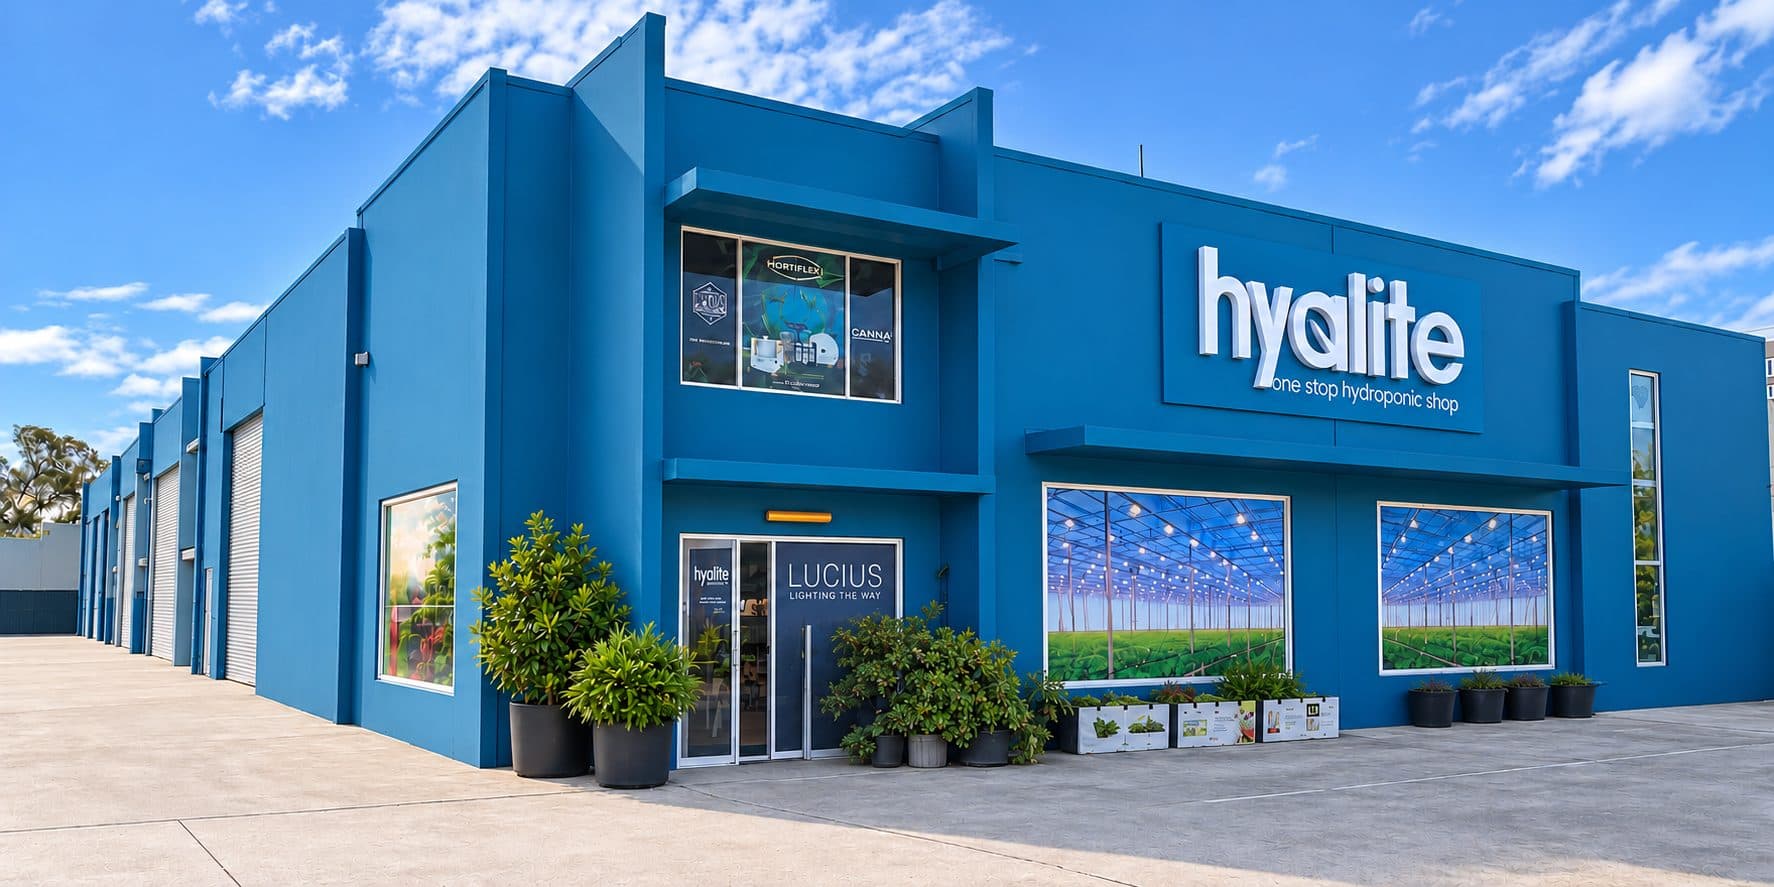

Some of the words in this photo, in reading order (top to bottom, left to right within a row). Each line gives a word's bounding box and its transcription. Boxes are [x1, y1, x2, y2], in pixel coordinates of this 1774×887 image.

[767, 259, 820, 276] HORTIFLEX
[1197, 245, 1465, 389] hyalite
[851, 328, 891, 340] CANNA
[1272, 377, 1301, 393] one
[1305, 379, 1338, 402] stop
[1342, 381, 1422, 408] hydroponic
[1426, 392, 1459, 416] shop
[694, 565, 729, 587] hyalite
[788, 563, 882, 588] LUCIUS
[789, 591, 836, 600] LIGHTING
[839, 591, 857, 600] THE
[860, 591, 881, 600] WAY
